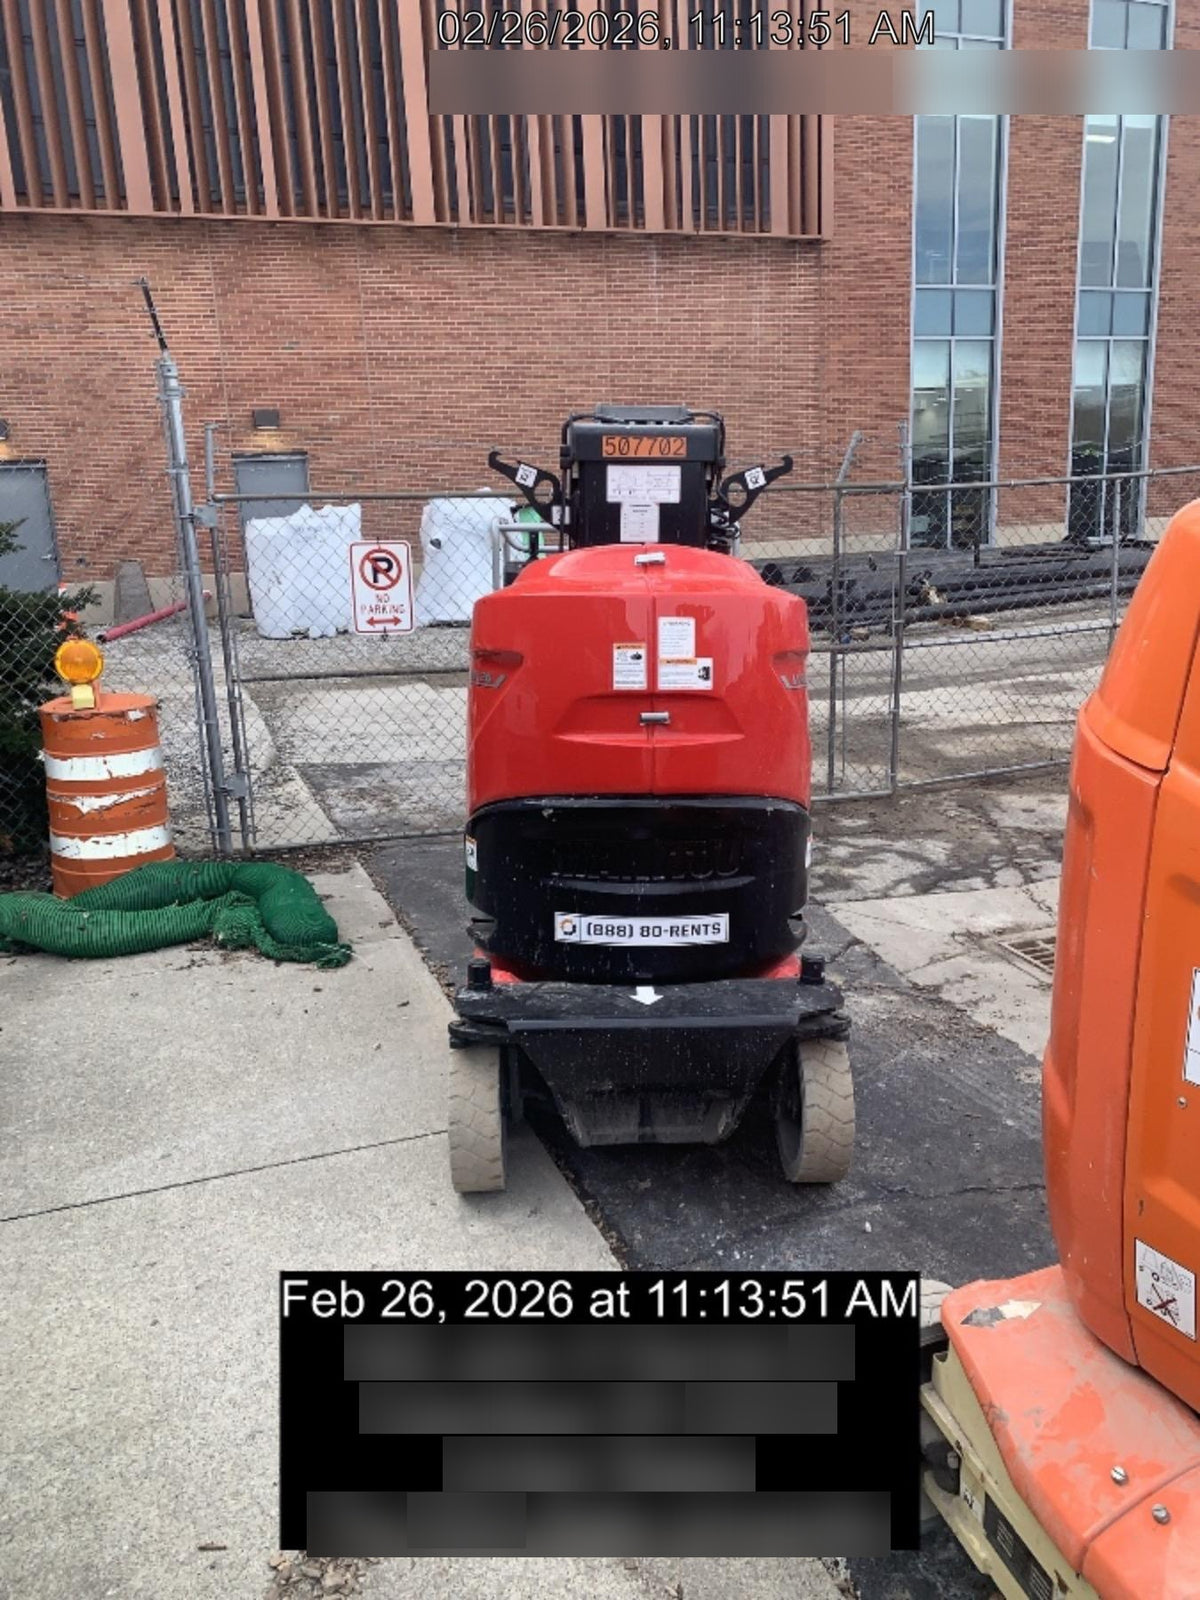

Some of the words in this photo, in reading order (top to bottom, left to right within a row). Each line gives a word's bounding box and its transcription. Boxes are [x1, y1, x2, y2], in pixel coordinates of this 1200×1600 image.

[604, 437, 685, 456] 507702
[375, 593, 390, 603] NO
[361, 604, 405, 614] PARKING
[587, 922, 634, 938] (888)
[640, 922, 721, 938] 80-RENTS
